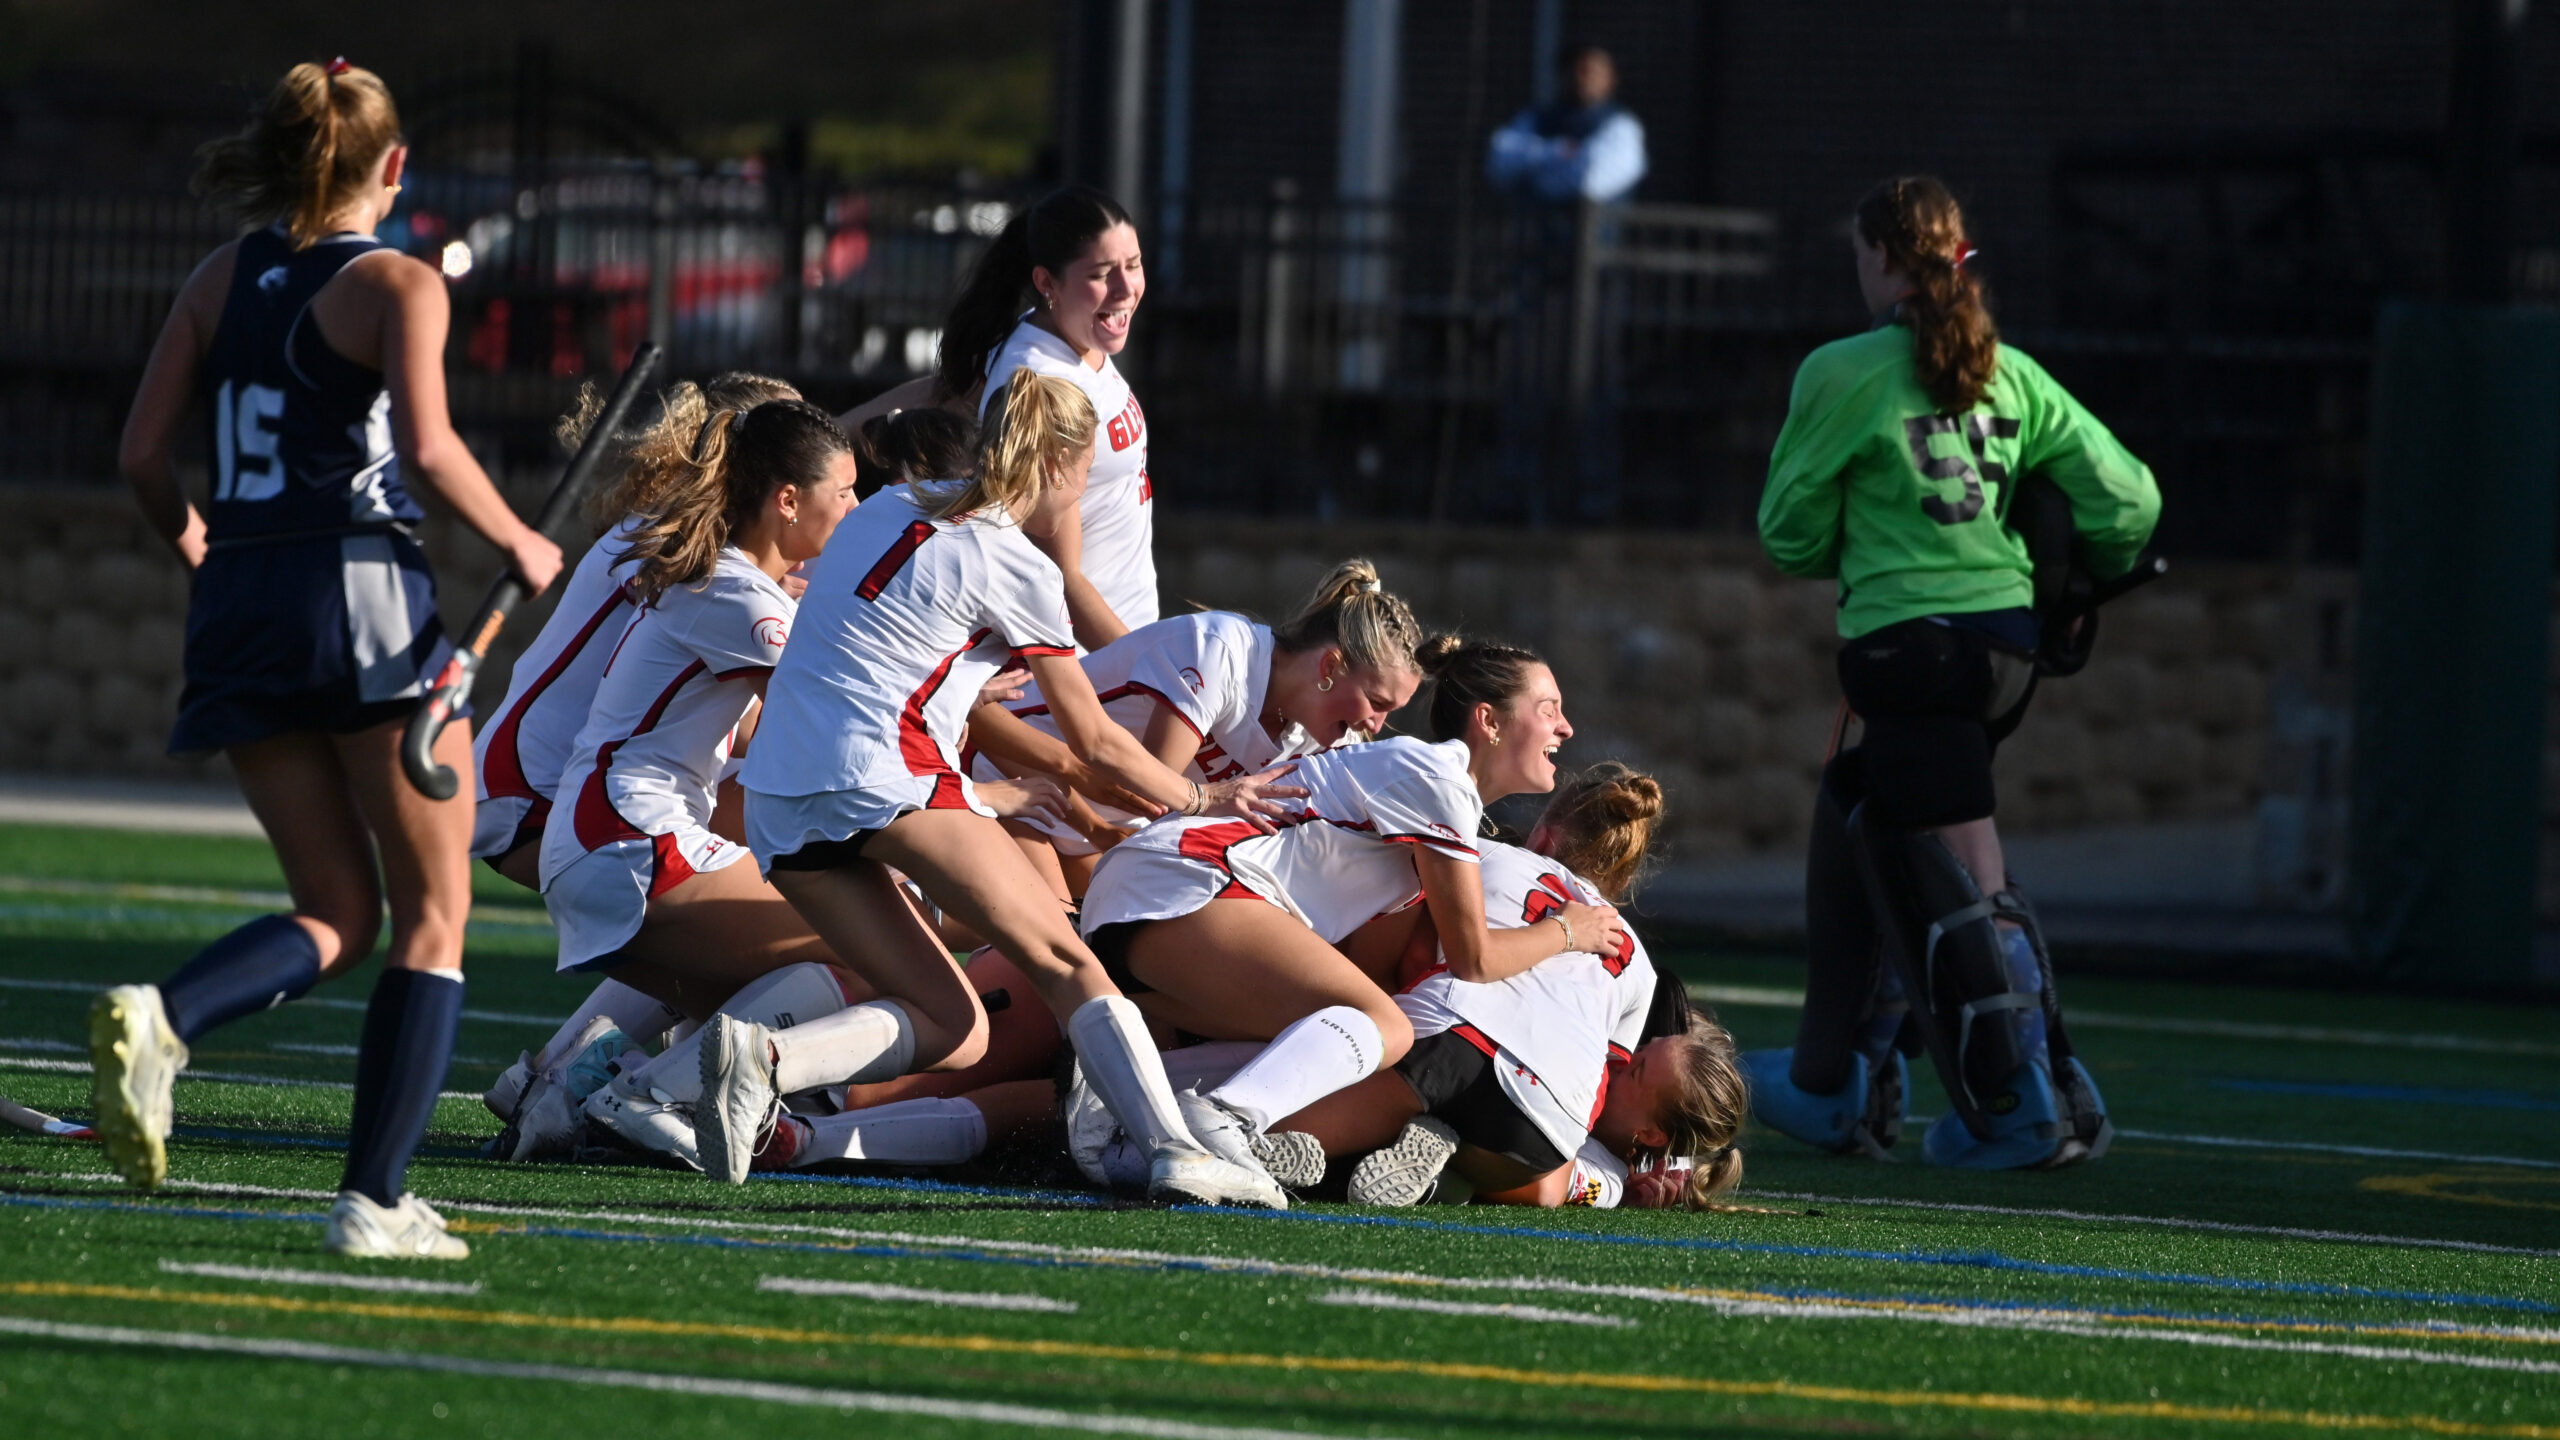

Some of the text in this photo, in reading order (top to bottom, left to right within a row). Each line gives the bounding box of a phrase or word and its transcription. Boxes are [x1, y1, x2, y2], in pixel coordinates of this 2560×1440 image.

[217, 379, 286, 501] 15
[1903, 413, 2021, 526] 55
[854, 519, 938, 603] 1
[1320, 1018, 1364, 1074] GRYPHON
